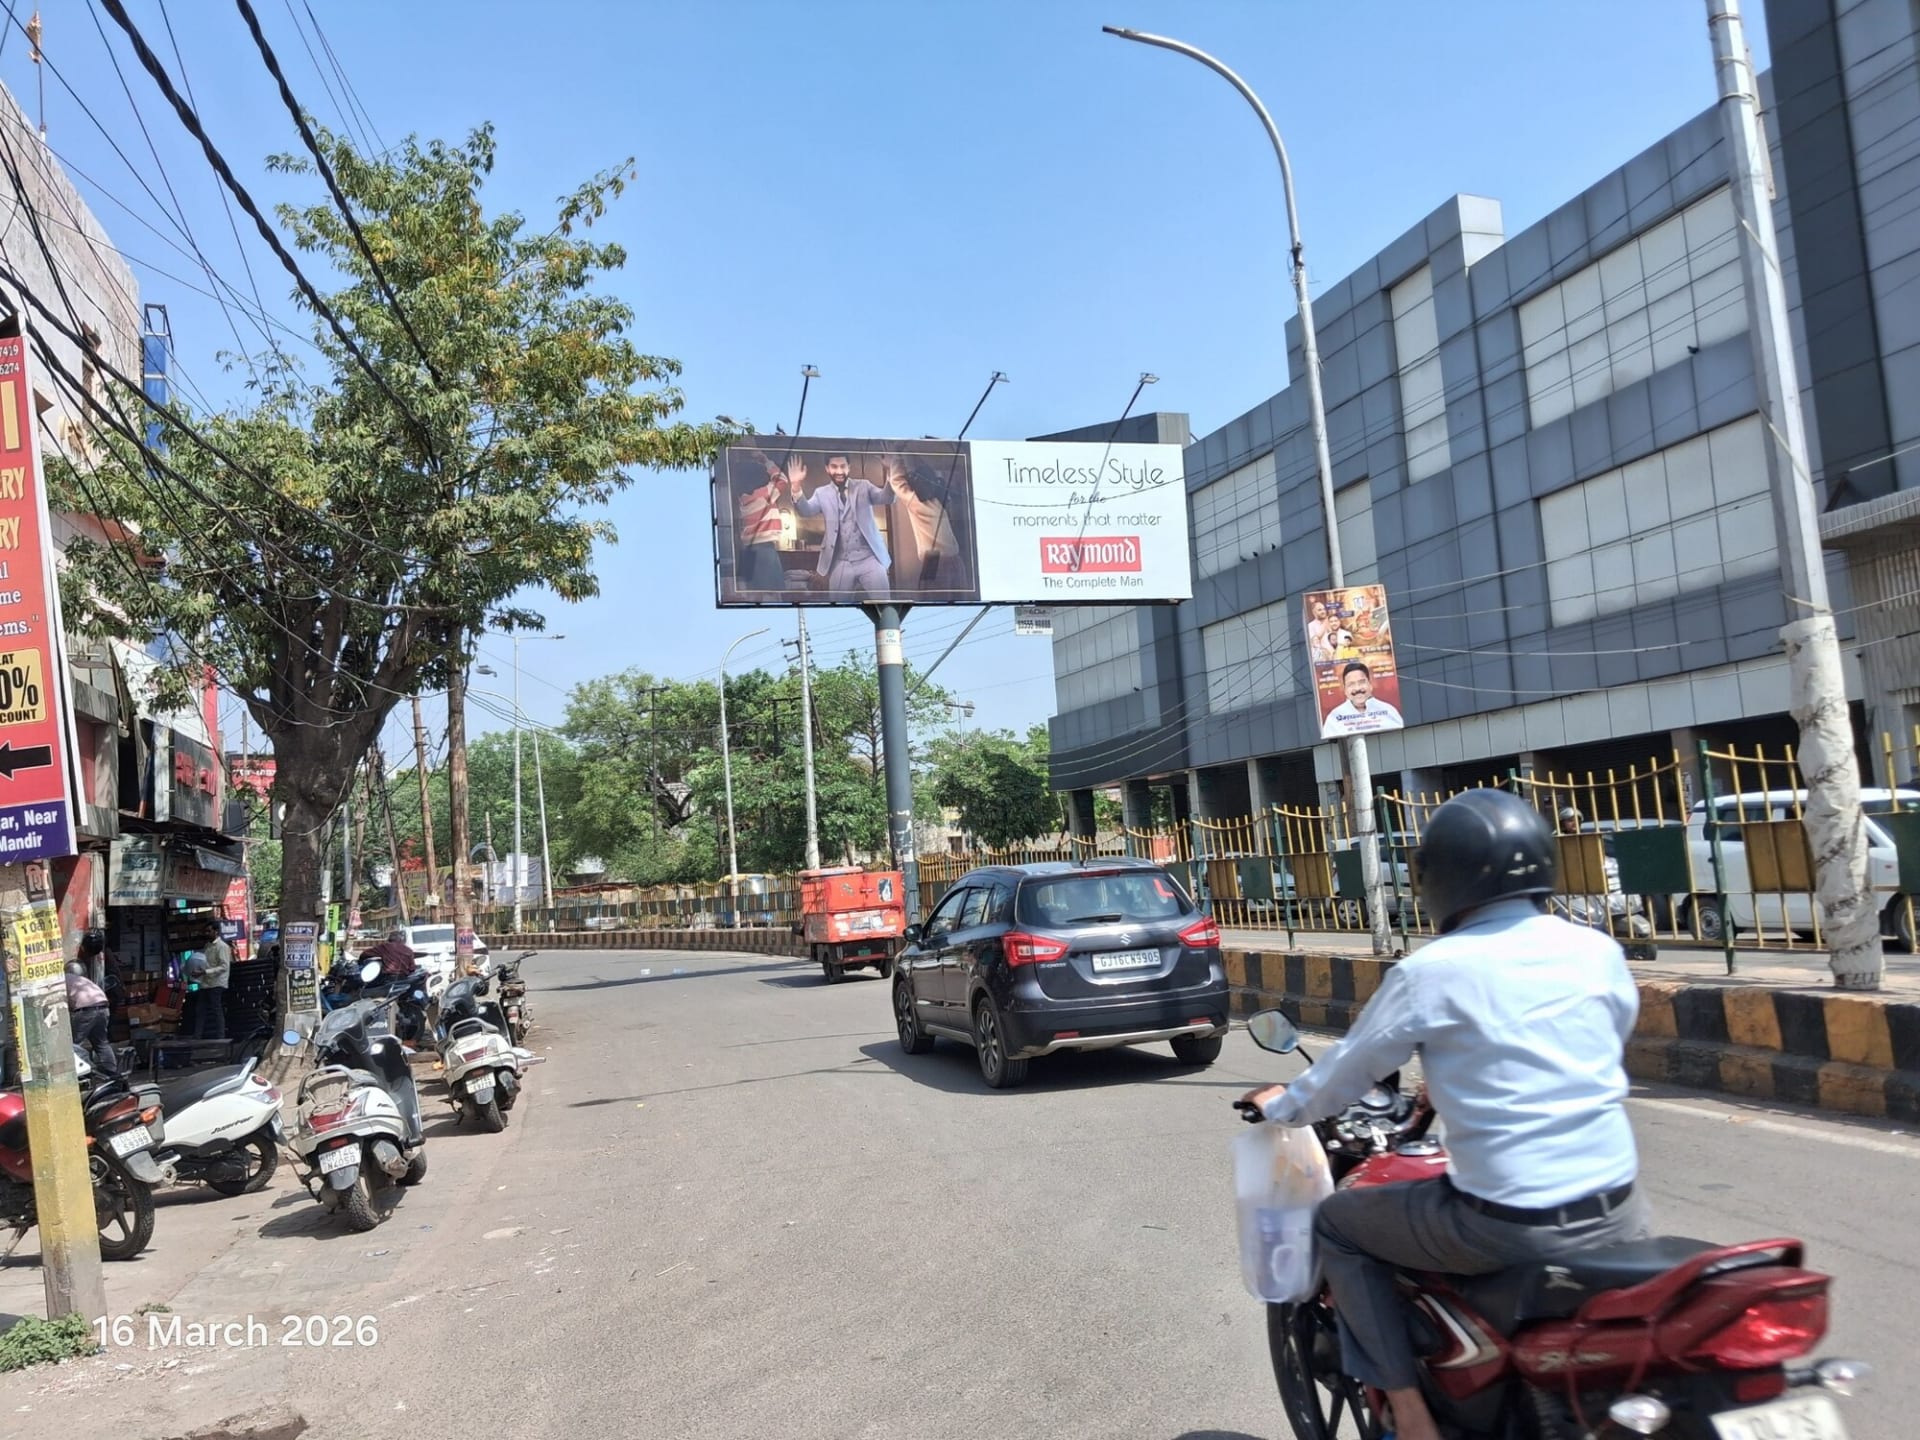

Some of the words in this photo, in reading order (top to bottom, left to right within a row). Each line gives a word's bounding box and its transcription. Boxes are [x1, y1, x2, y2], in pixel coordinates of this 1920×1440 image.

[1002, 458, 1099, 484] Timeless
[1108, 458, 1165, 490] Style
[0, 467, 25, 500] RY
[1068, 492, 1086, 509] for
[1088, 491, 1106, 504] the
[1013, 513, 1078, 527] moments
[1084, 513, 1111, 526] that
[1117, 513, 1162, 527] matter
[1043, 577, 1063, 588] The
[1066, 577, 1116, 590] Complete
[1120, 576, 1144, 587] Man
[0, 654, 14, 665] AT
[24, 809, 57, 827] Near
[0, 831, 42, 852] Mandir
